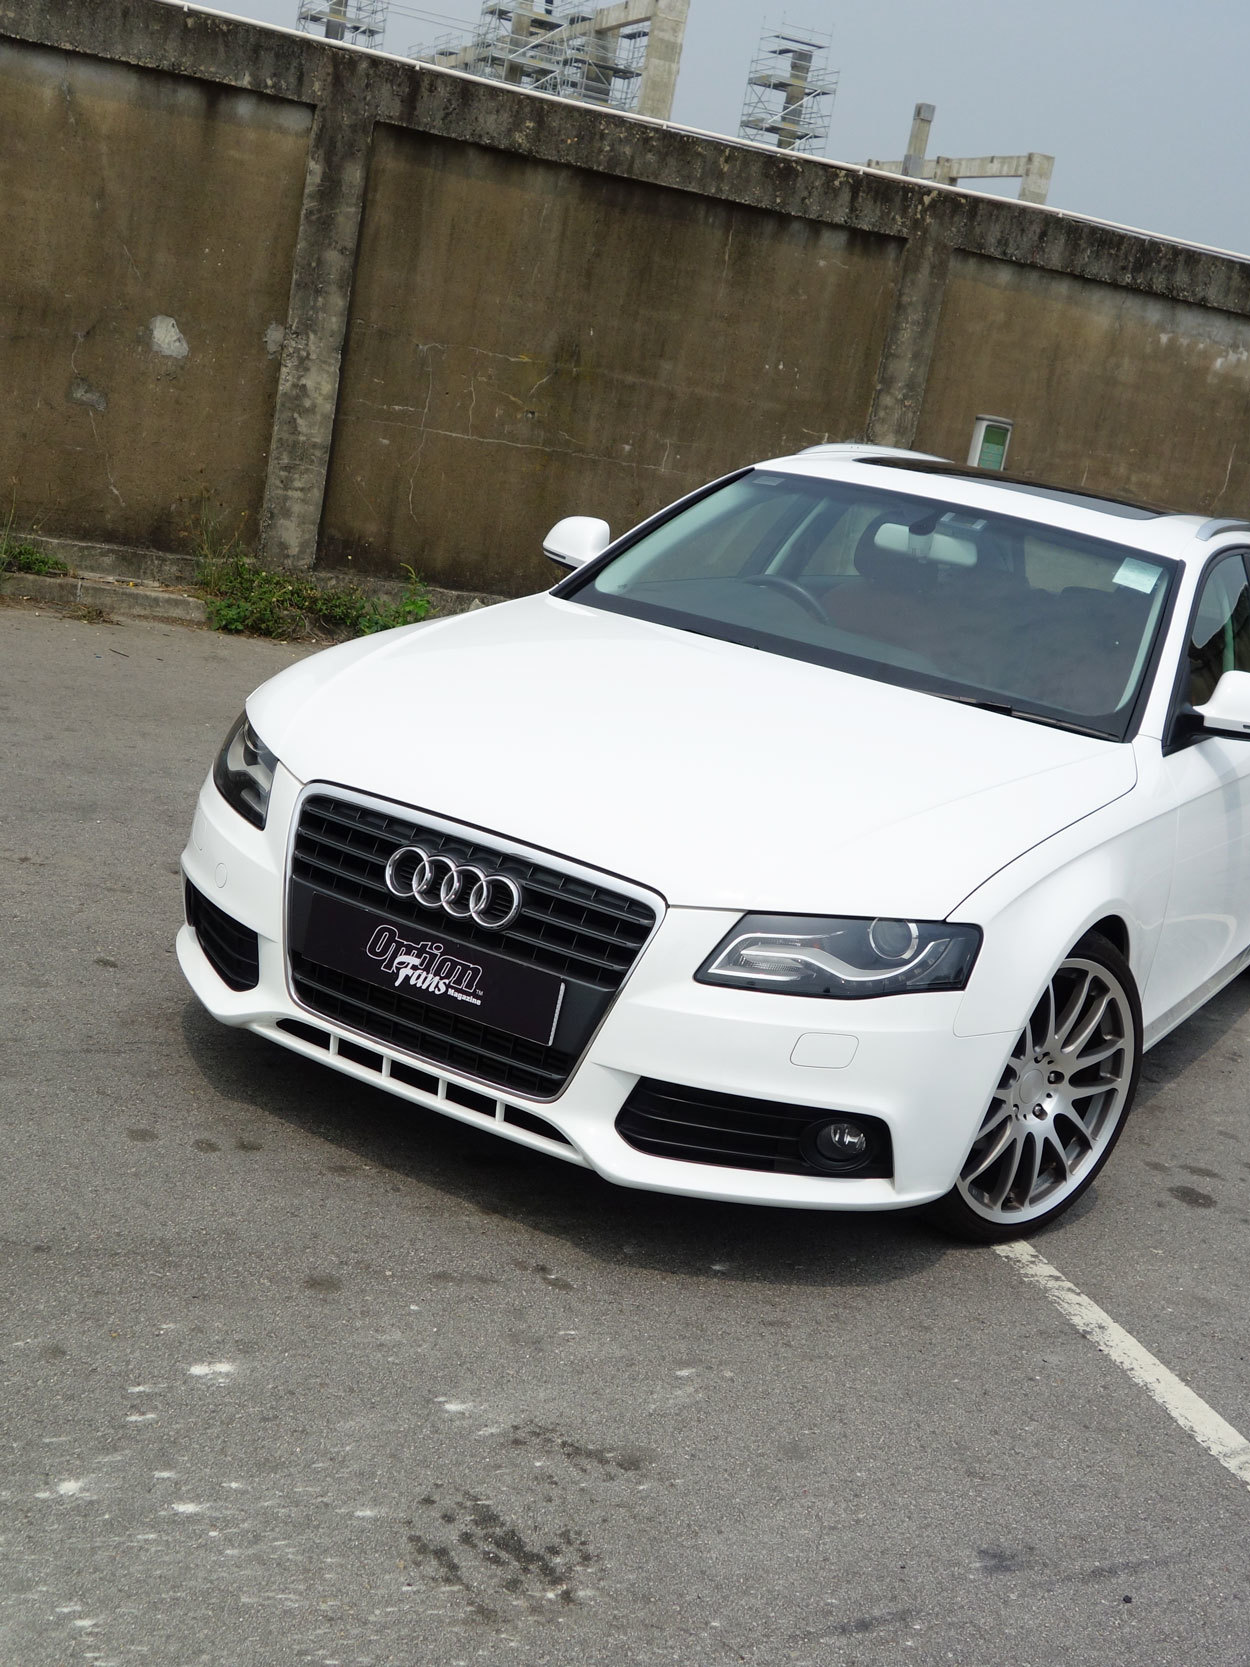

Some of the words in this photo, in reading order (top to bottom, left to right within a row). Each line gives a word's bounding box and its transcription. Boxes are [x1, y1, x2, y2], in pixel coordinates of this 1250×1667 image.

[366, 924, 483, 993] Option
[393, 954, 450, 995] Fans
[446, 987, 482, 1006] Magazine
